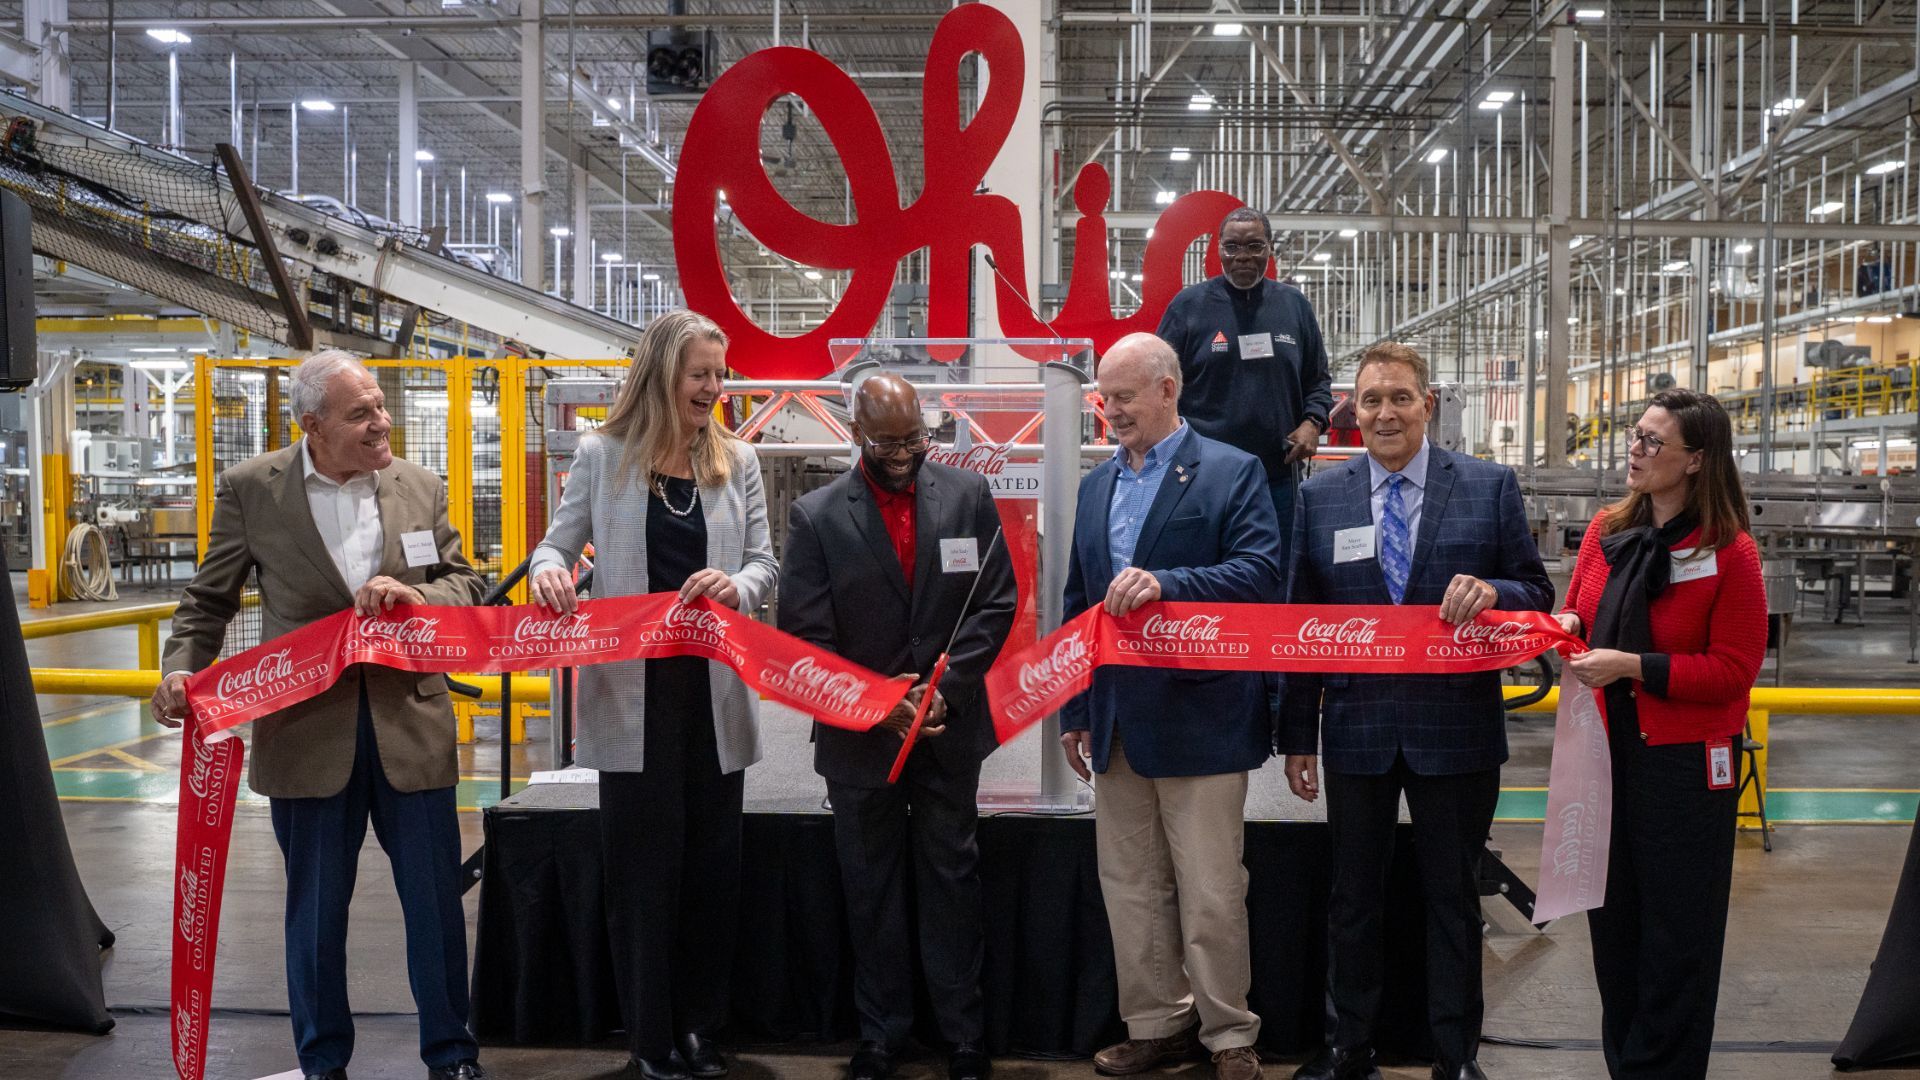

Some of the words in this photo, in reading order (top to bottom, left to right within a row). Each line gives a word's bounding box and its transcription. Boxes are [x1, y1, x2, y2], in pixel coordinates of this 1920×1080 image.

[672, 2, 1277, 380] Ohio
[359, 616, 440, 643] Coca-Cola
[489, 636, 620, 657] CONSOLIDATED
[514, 612, 592, 642] Coca-Cola
[664, 602, 732, 639] Coca-Cola
[1142, 613, 1224, 641] Coca-Cola
[1298, 617, 1381, 644] Coca-Cola
[1427, 636, 1551, 657] CONSOLIDATED
[1454, 619, 1534, 643] Coca-Cola
[217, 646, 292, 700] Coca-Cola
[640, 629, 745, 668] CONSOLIDATED
[1019, 629, 1087, 693] Coca-Cola
[1117, 639, 1250, 655] CONSOLIDATED
[1272, 643, 1406, 657] CONSOLIDATED
[196, 662, 329, 722] CONSOLIDATED
[760, 668, 886, 722] CONSOLIDATED
[789, 656, 869, 706] Coca-Cola
[1005, 650, 1094, 722] CONSOLIDA
[188, 720, 215, 798] Coca-Co
[206, 740, 229, 826] CONSOLID
[179, 862, 198, 942] Coca-Cola
[193, 846, 212, 971] CONSOLIDATED
[176, 1001, 191, 1079] Coca-Cola
[188, 989, 200, 1080] NSOLIDATED
